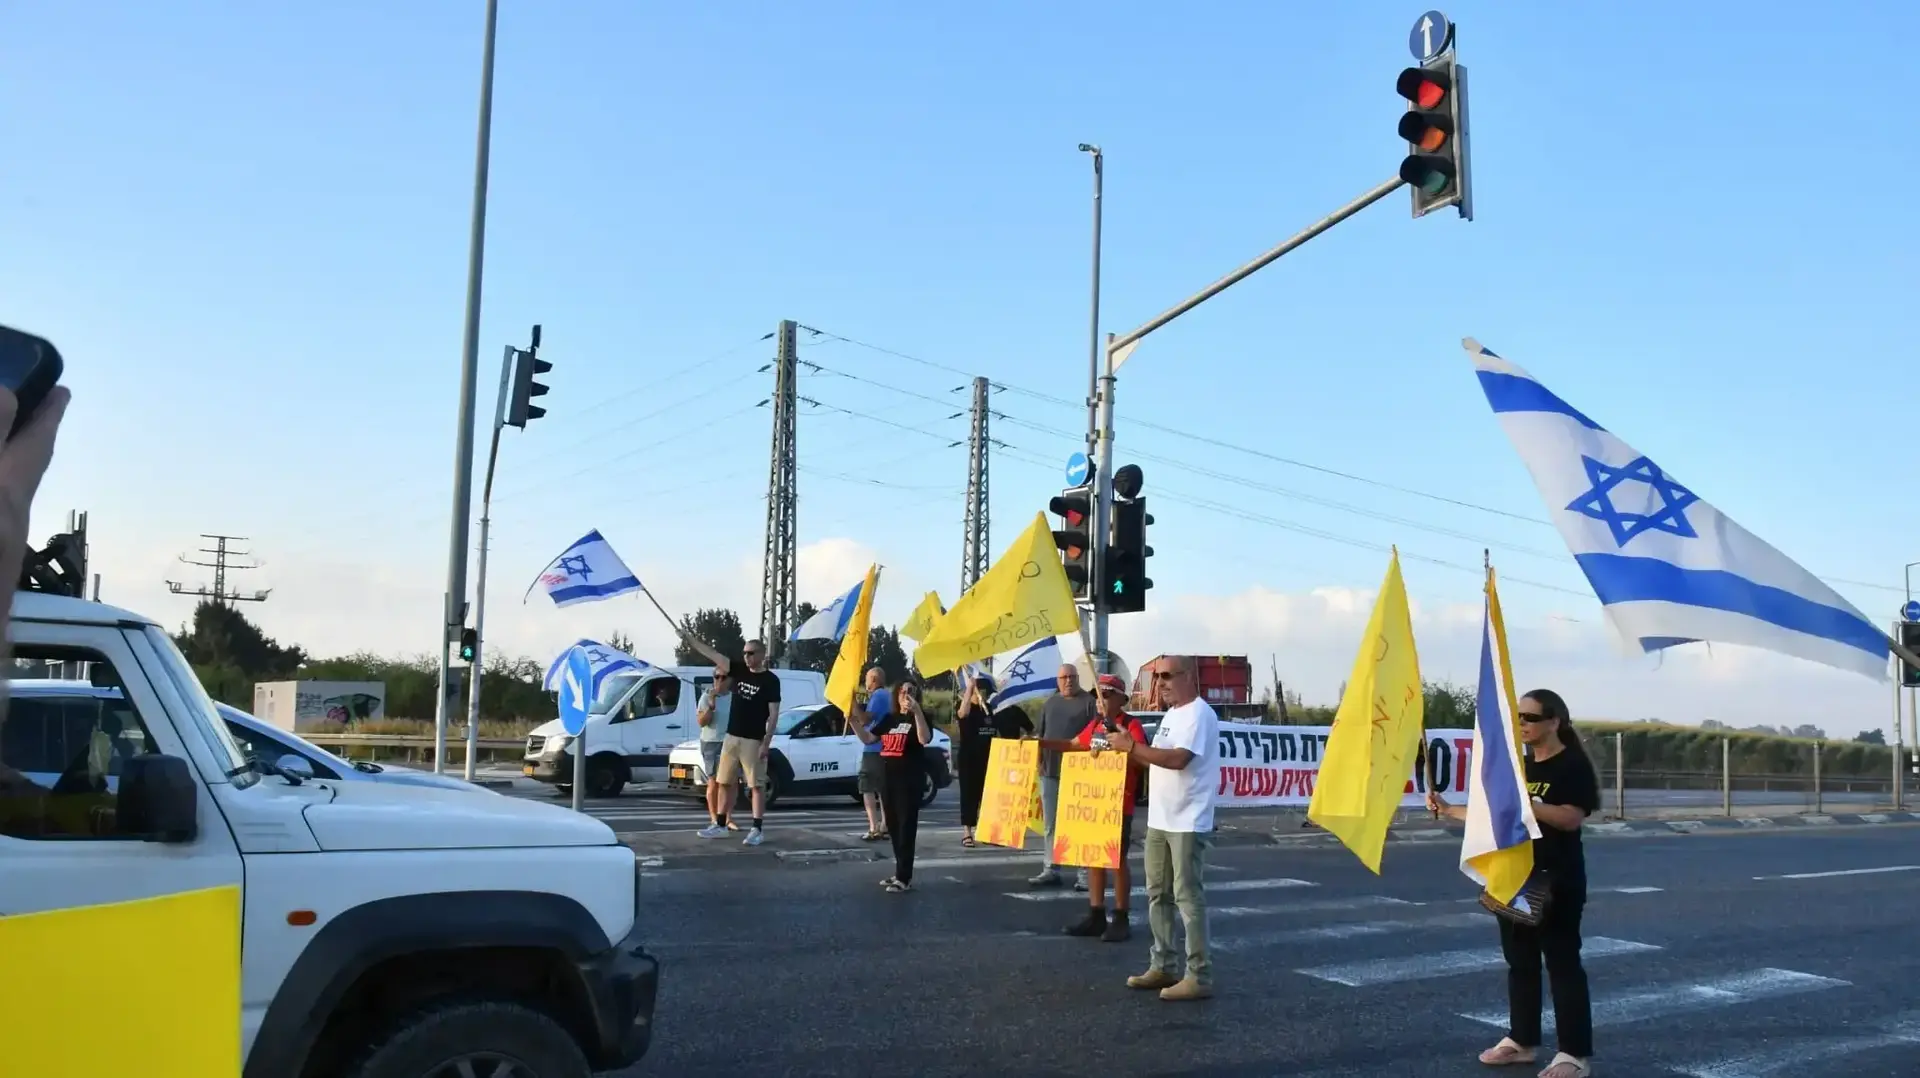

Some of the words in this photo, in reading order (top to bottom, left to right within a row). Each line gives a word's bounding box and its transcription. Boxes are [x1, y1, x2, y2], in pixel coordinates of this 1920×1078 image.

[1219, 731, 1297, 763] חקירה
[1110, 780, 1124, 802] לא
[1218, 766, 1277, 797] עכשיו
